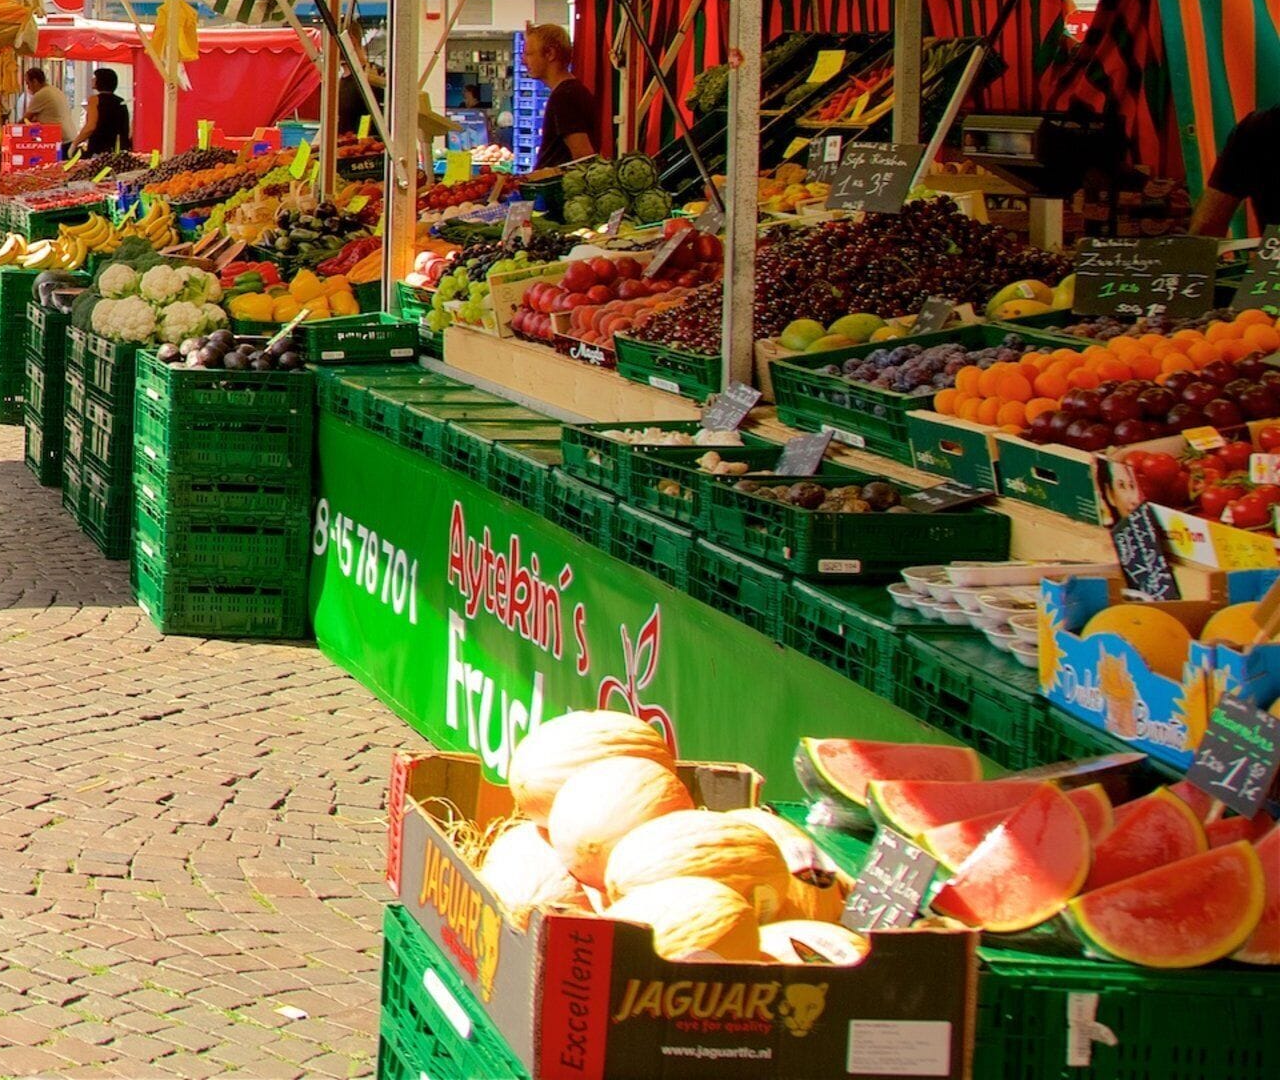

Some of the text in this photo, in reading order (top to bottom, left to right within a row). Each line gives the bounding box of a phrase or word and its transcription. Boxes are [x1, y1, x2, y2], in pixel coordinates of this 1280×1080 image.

[419, 837, 483, 959] JAGUAR
[560, 929, 595, 1072] Excellent
[612, 978, 782, 1023] JAGUAR
[675, 1019, 773, 1034] eye for quality
